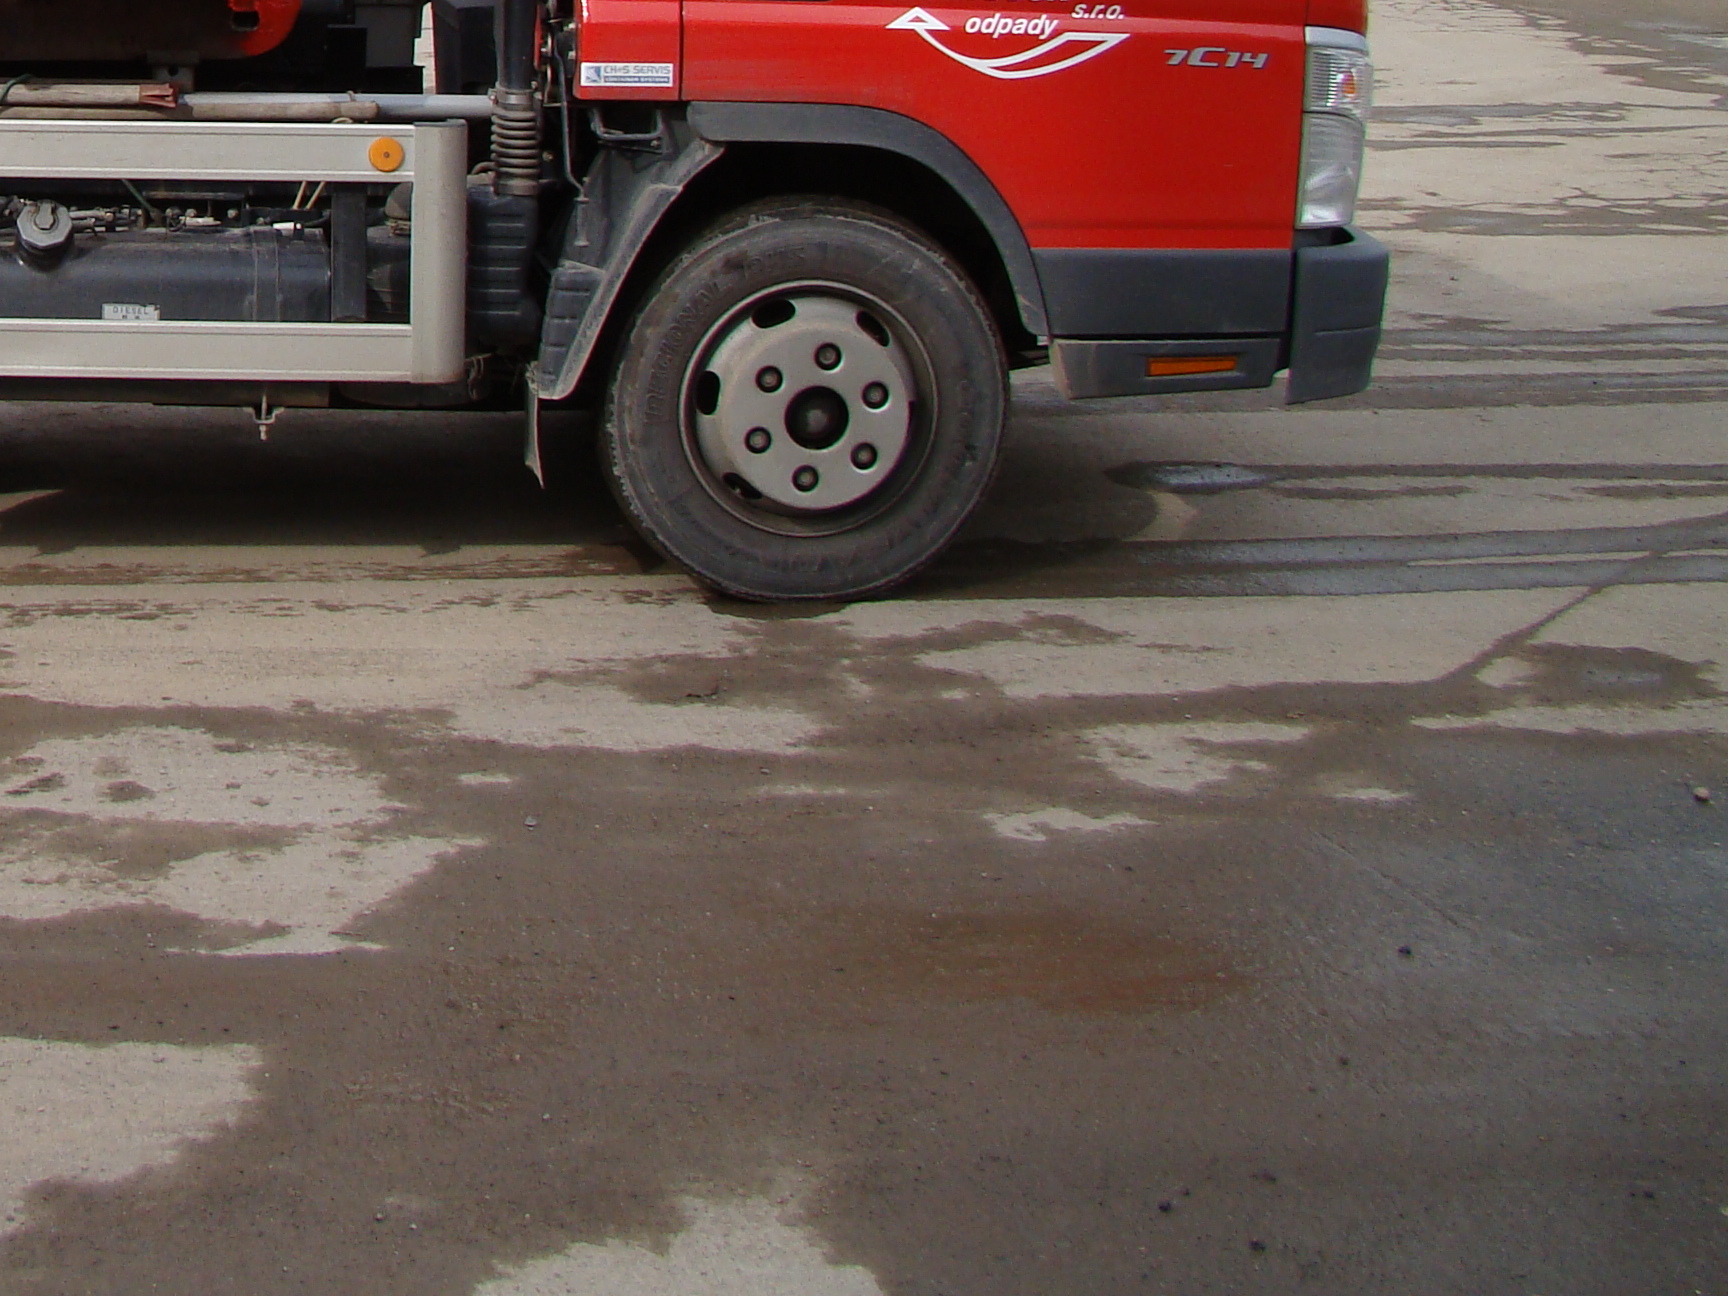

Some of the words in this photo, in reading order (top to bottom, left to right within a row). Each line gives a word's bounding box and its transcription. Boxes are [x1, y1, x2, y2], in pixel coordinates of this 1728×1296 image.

[1071, 1, 1126, 20] s.r.o.
[964, 12, 1060, 39] odpady
[1162, 46, 1270, 69] 7C14
[632, 65, 671, 74] SERVIS
